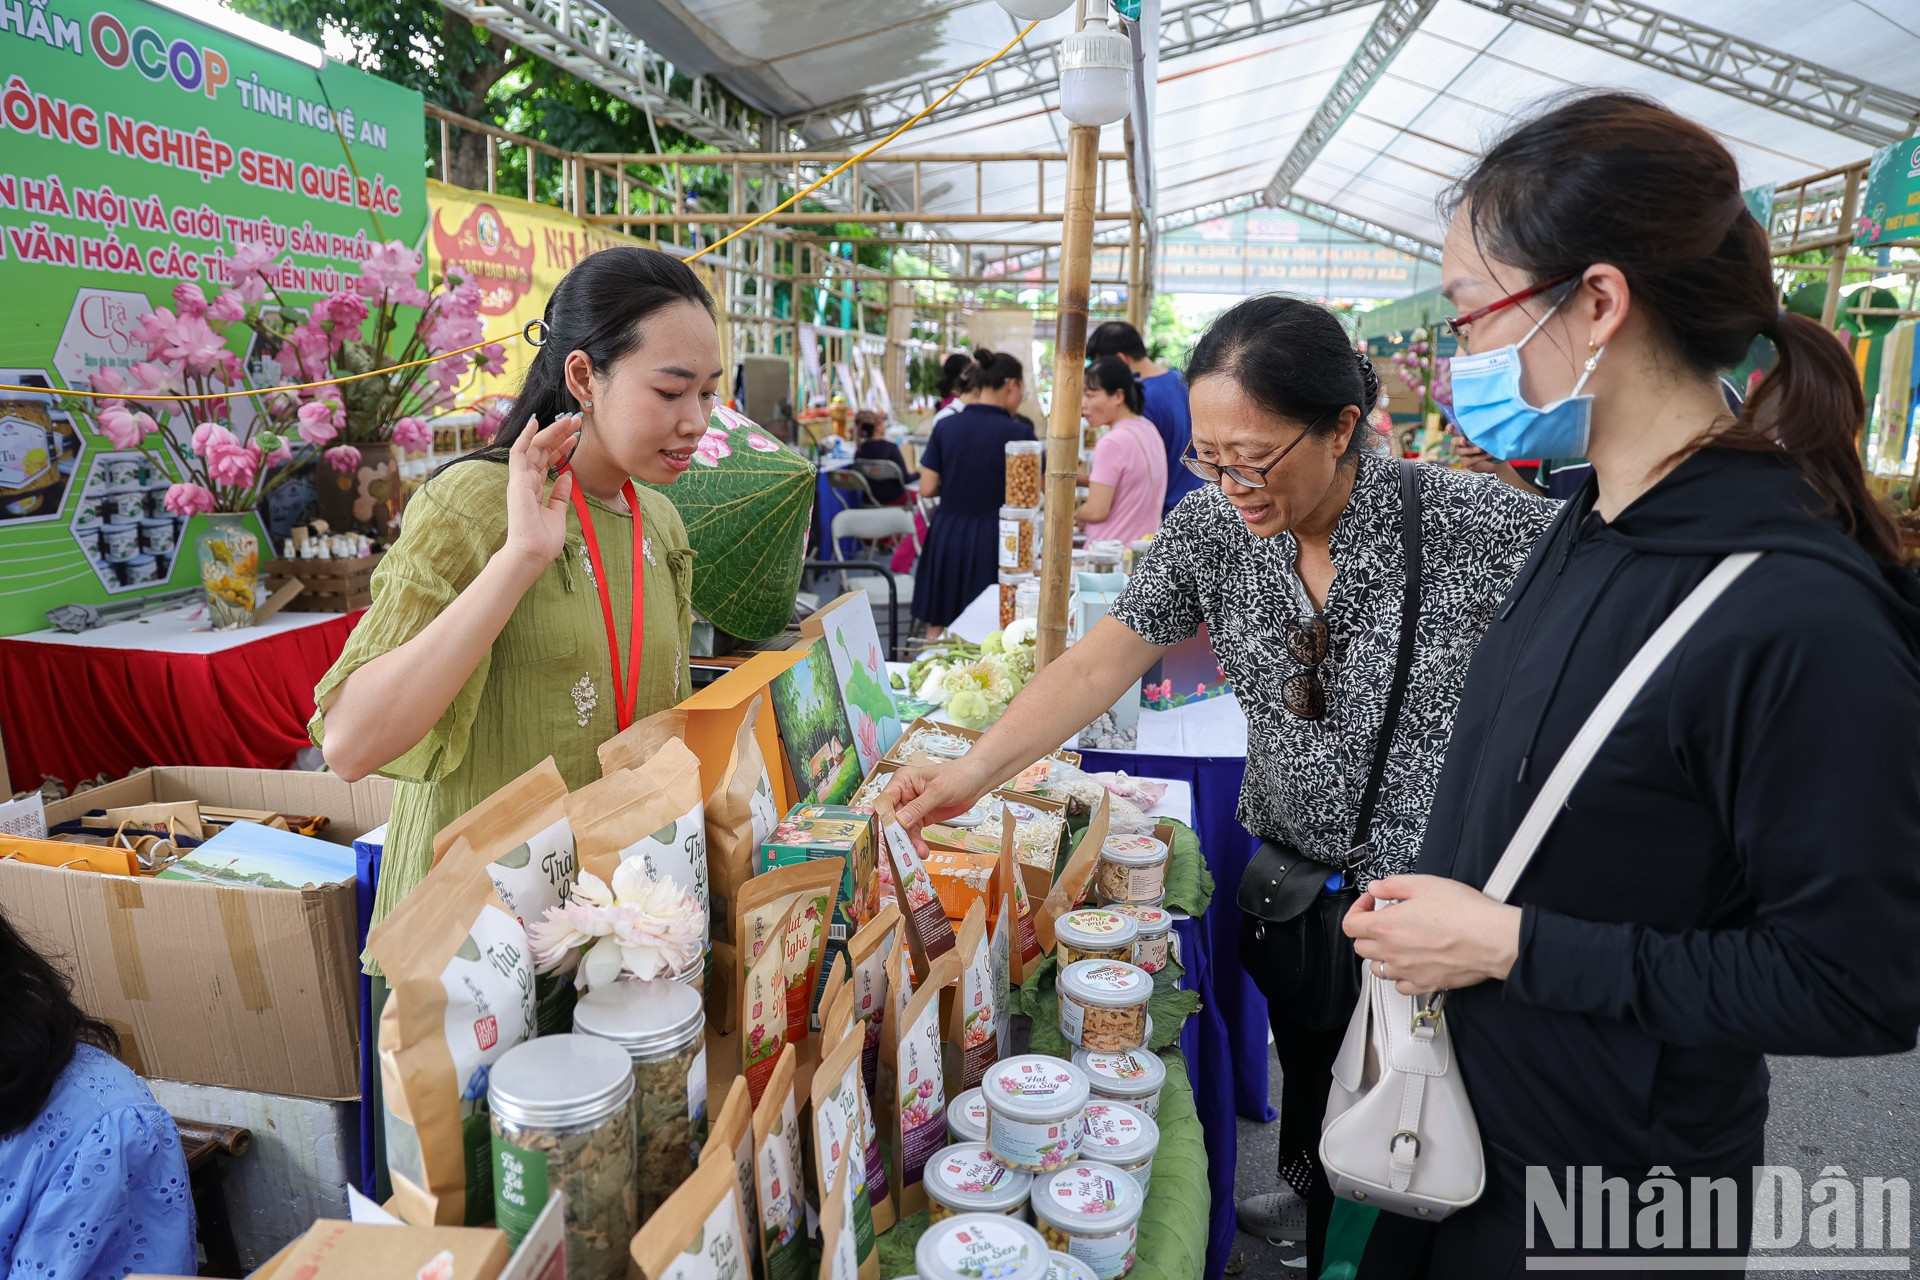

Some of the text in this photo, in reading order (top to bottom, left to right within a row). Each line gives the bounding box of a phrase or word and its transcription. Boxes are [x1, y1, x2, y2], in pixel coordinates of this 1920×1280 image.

[90, 12, 229, 99] OCOP
[235, 72, 293, 121] TỈNH
[297, 98, 355, 143] NGHỆ
[359, 120, 388, 149] AN
[0, 77, 400, 214] ÔNG NGHIỆP SEN QUÊ BÁC
[23, 178, 70, 215] HÀ
[76, 188, 127, 228] NỘI
[132, 198, 168, 232] VÀ
[173, 207, 221, 239] GIỚI
[225, 218, 285, 248] THIỆU
[290, 222, 328, 255] SẢN
[10, 225, 75, 264] VĂN
[83, 236, 143, 272] HÓA
[150, 246, 199, 278] CÁC
[311, 266, 340, 293] NÚI
[80, 295, 127, 339] Trà
[541, 850, 574, 886] Trà
[486, 942, 521, 978] Trà
[1017, 1082, 1038, 1090] Sen
[501, 1151, 525, 1174] Trà
[502, 1184, 528, 1206] Sen
[966, 1242, 994, 1255] Trà
[991, 1244, 1018, 1260] Sen
